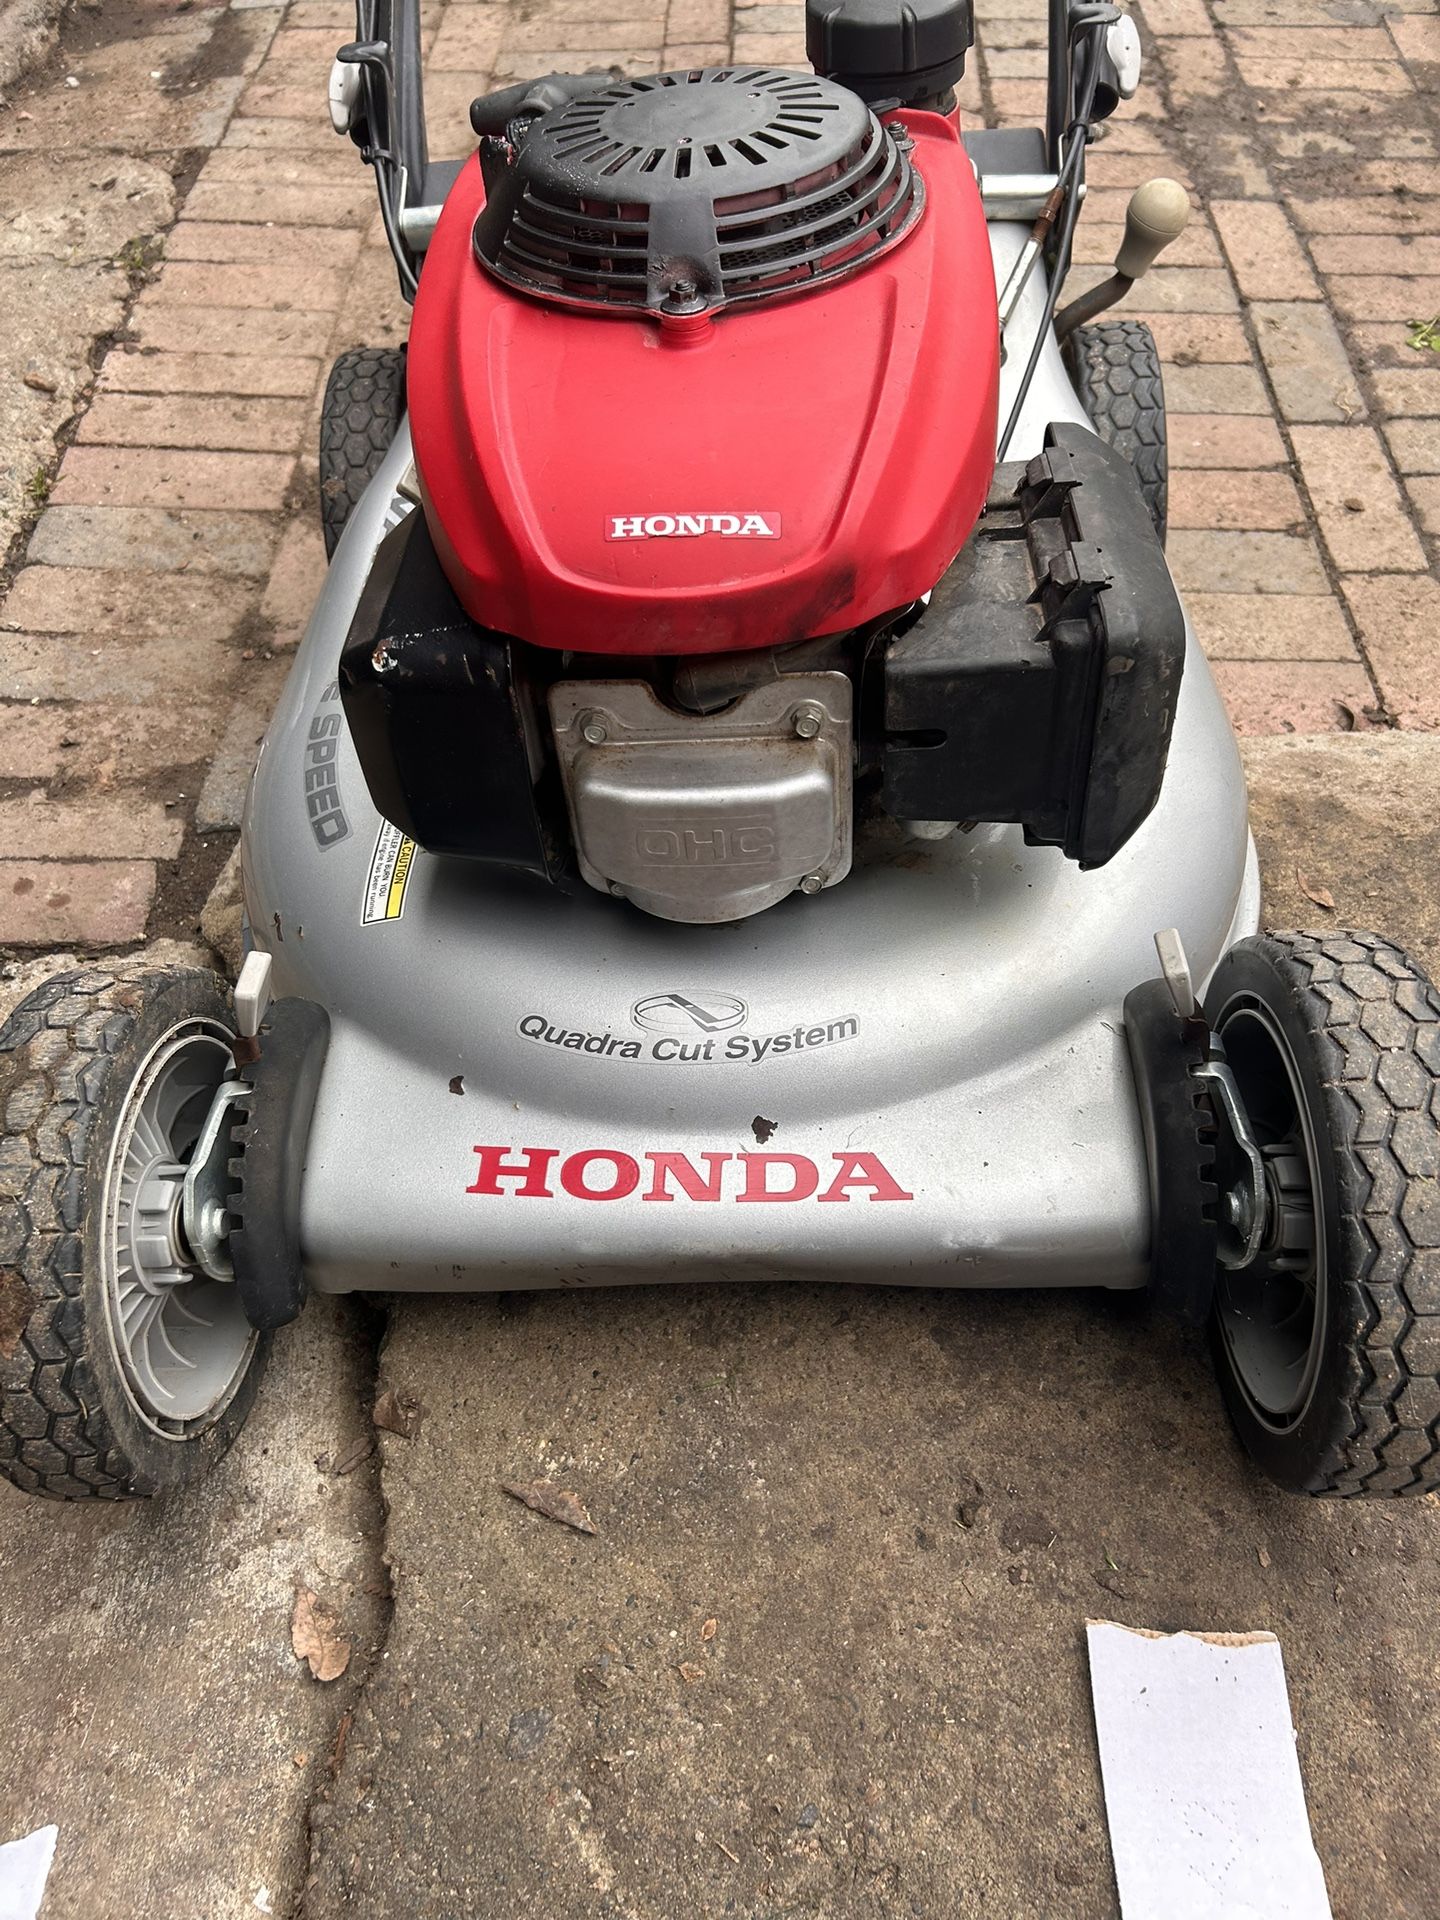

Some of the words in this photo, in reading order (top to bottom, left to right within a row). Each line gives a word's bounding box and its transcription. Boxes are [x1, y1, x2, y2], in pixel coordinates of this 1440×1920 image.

[611, 514, 774, 538] HONDA
[305, 713, 349, 846] SPEED
[386, 849, 396, 863] CAN
[635, 826, 775, 861] OHC
[375, 862, 384, 874] has
[382, 863, 392, 881] BURN
[394, 846, 411, 885] CAUTION
[371, 875, 381, 891] been
[519, 1015, 642, 1059] Quadra
[652, 1038, 715, 1061] Cut
[725, 1017, 857, 1063] System
[466, 1146, 914, 1202] HONDA
